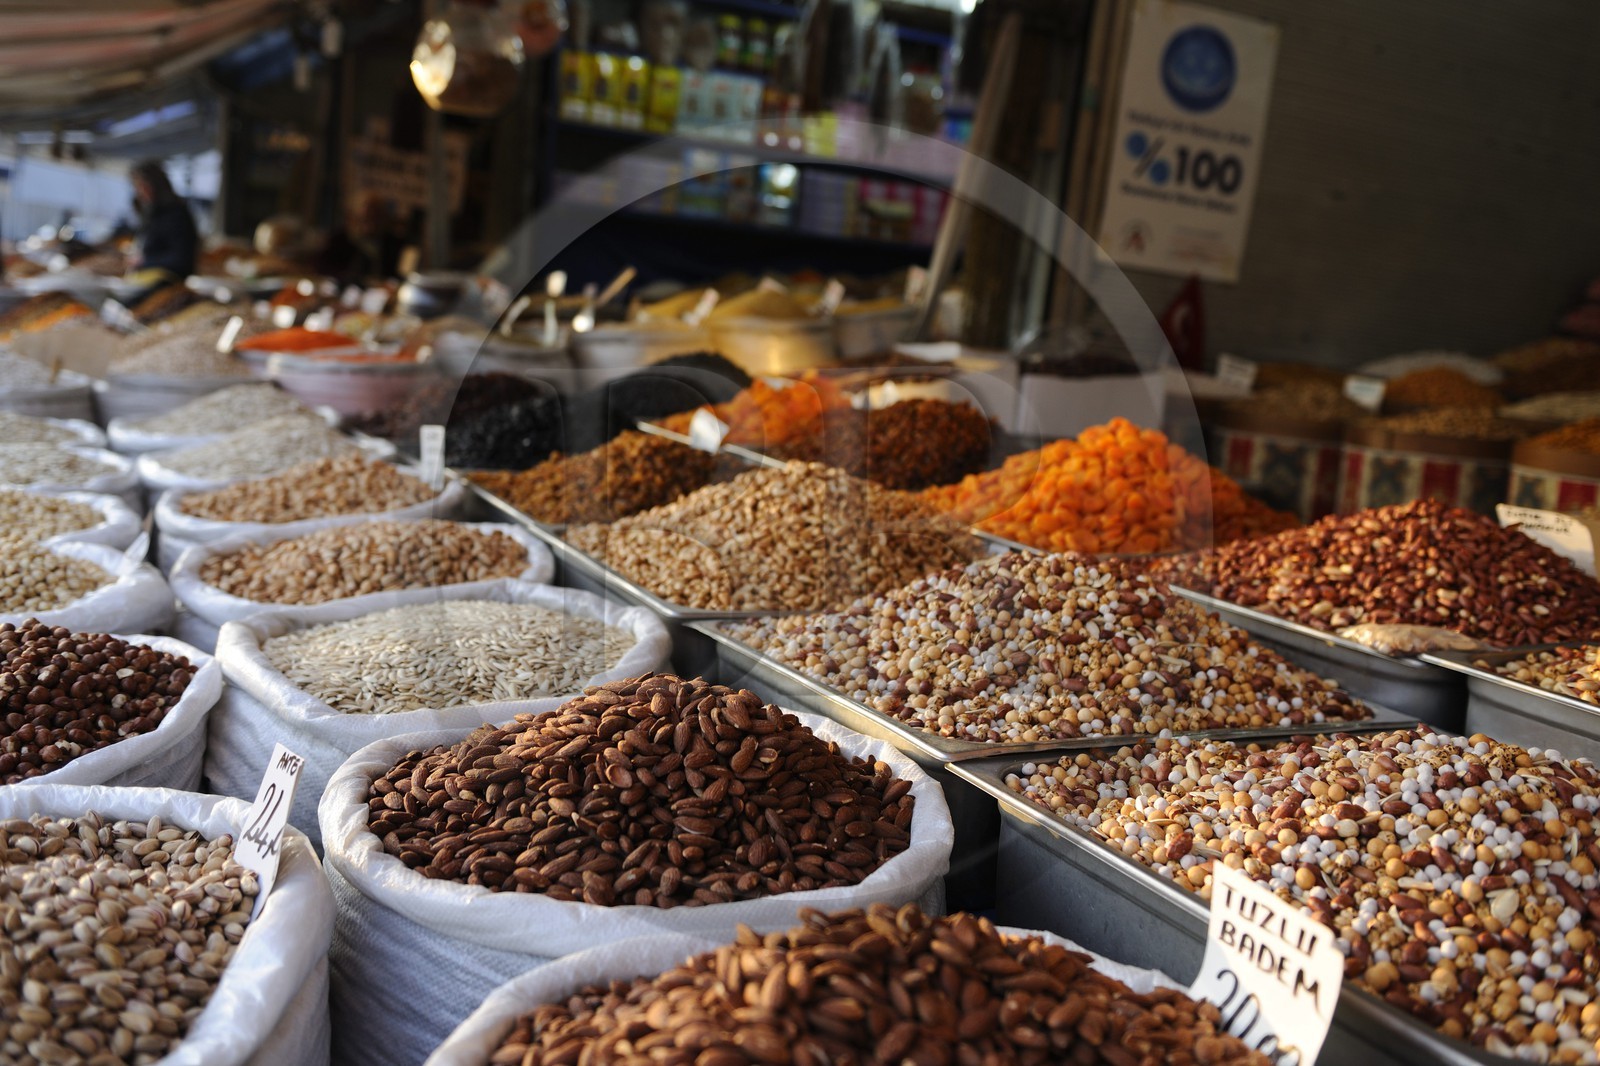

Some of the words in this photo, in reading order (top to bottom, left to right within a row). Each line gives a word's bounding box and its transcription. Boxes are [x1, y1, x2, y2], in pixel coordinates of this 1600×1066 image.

[1125, 131, 1243, 195] %100
[1221, 882, 1317, 958] TUZLU
[1219, 920, 1322, 1017] BADEM
